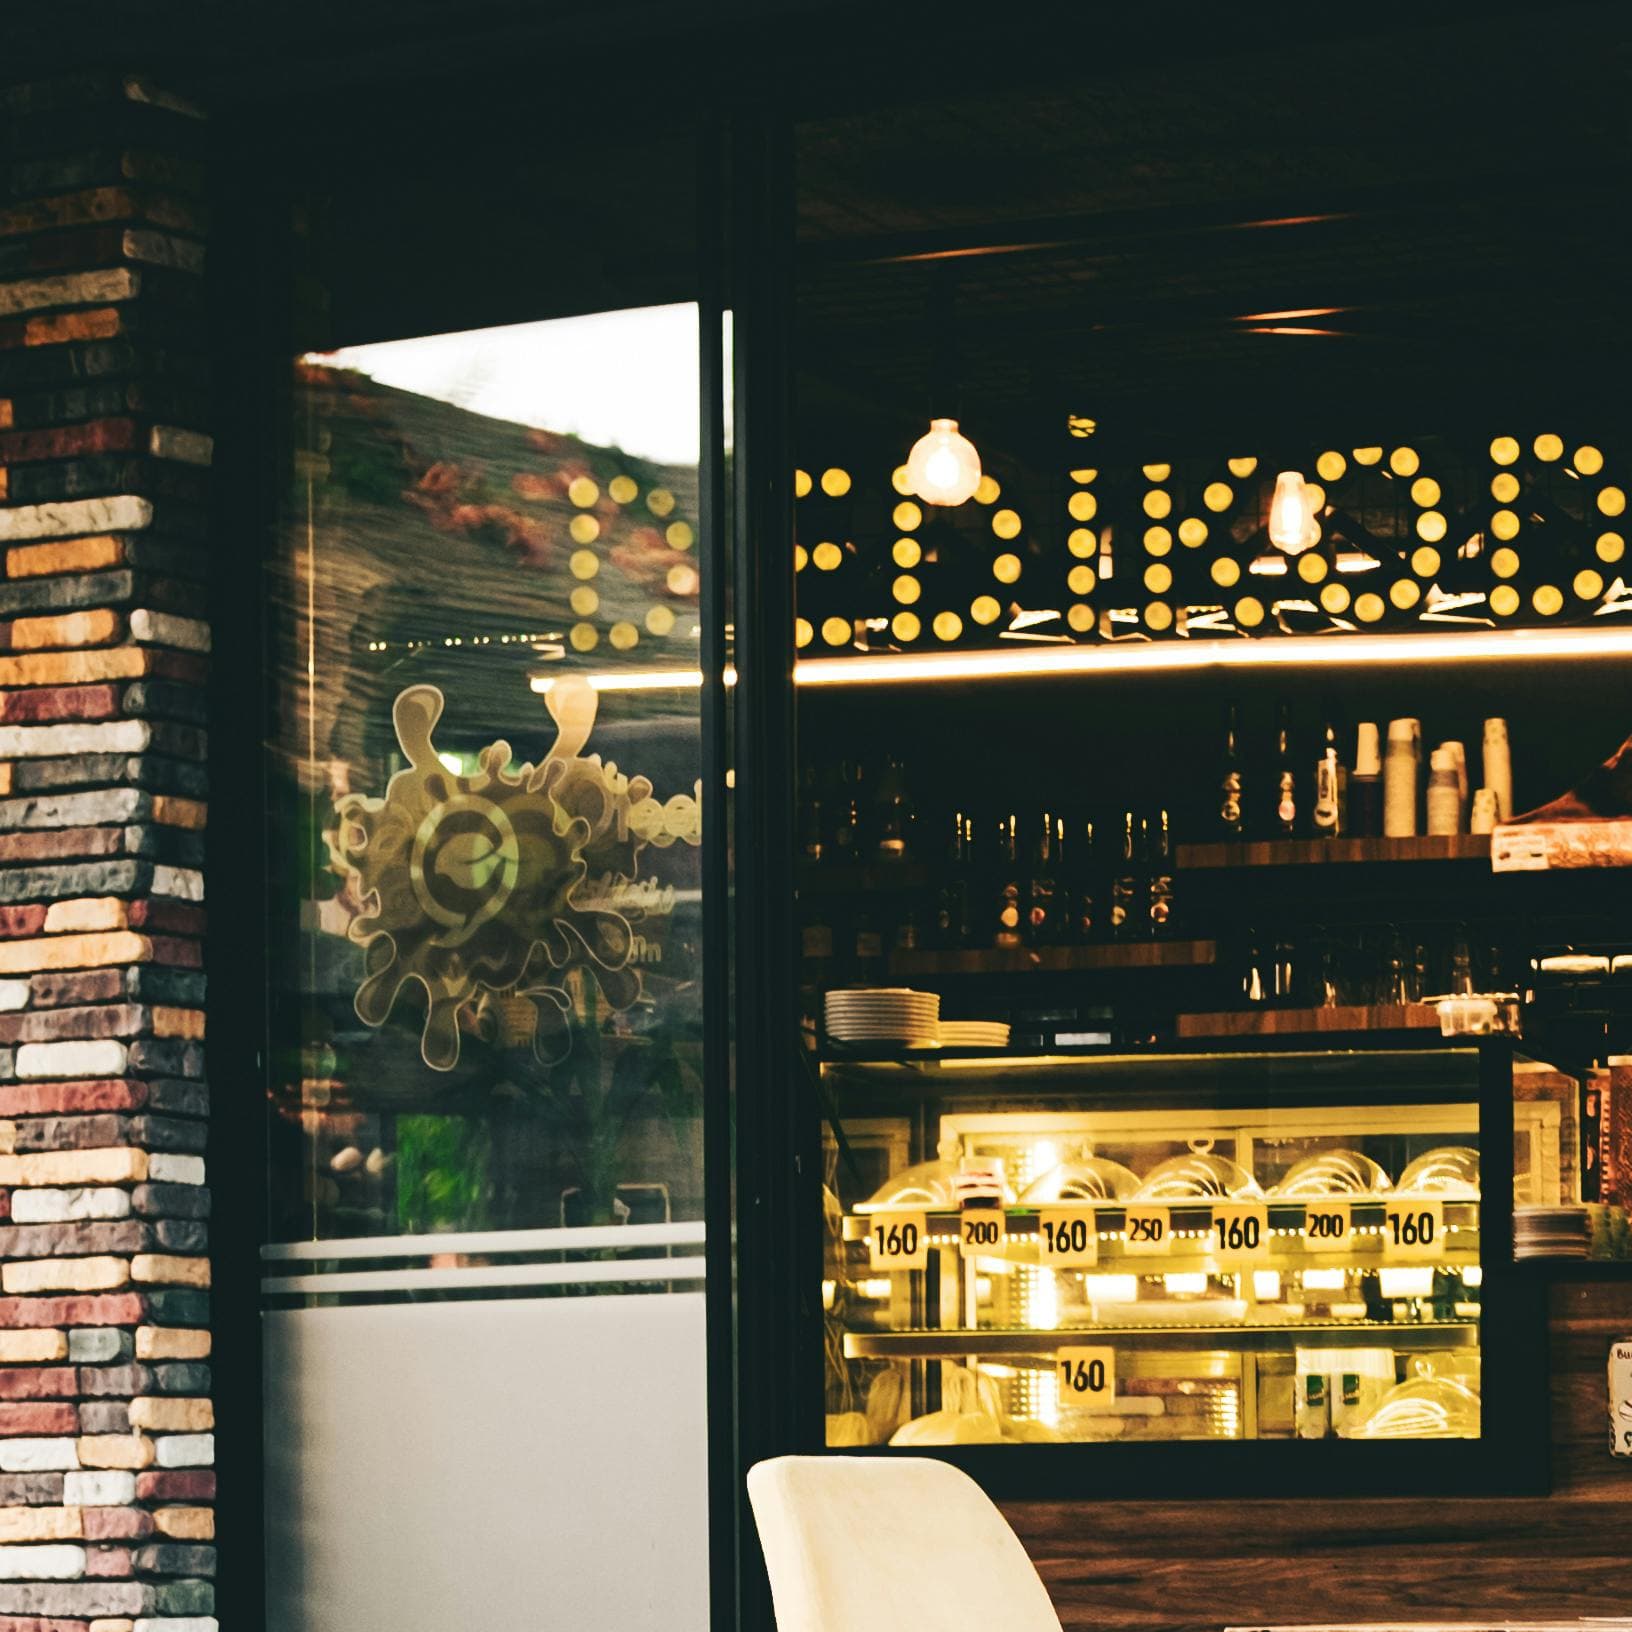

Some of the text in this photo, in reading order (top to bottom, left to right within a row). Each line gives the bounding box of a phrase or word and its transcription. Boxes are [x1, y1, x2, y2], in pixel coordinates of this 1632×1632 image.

[874, 1223, 918, 1256] 160
[964, 1221, 999, 1245] 200
[1042, 1219, 1087, 1254] 160
[1129, 1218, 1163, 1242] 250
[1214, 1216, 1260, 1250] 160
[1308, 1213, 1343, 1238] 200
[1387, 1210, 1434, 1245] 160
[1061, 1359, 1105, 1393] 160
